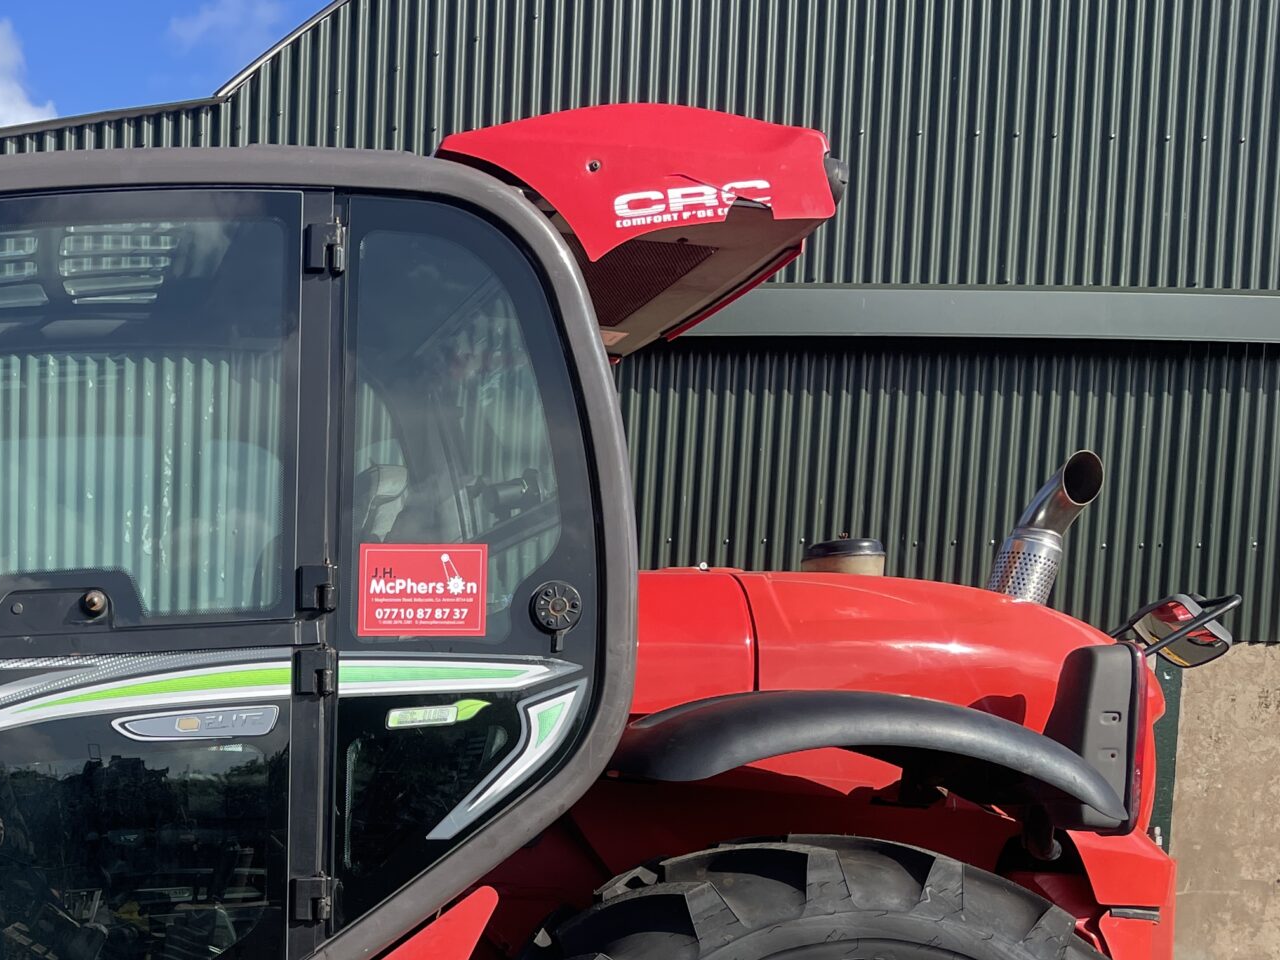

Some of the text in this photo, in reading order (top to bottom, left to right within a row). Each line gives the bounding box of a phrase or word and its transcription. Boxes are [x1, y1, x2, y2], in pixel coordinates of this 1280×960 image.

[614, 179, 771, 218] CRC
[616, 212, 678, 228] COMFORT
[371, 567, 397, 579] J.H.
[375, 608, 468, 620] 07710 87 87 37
